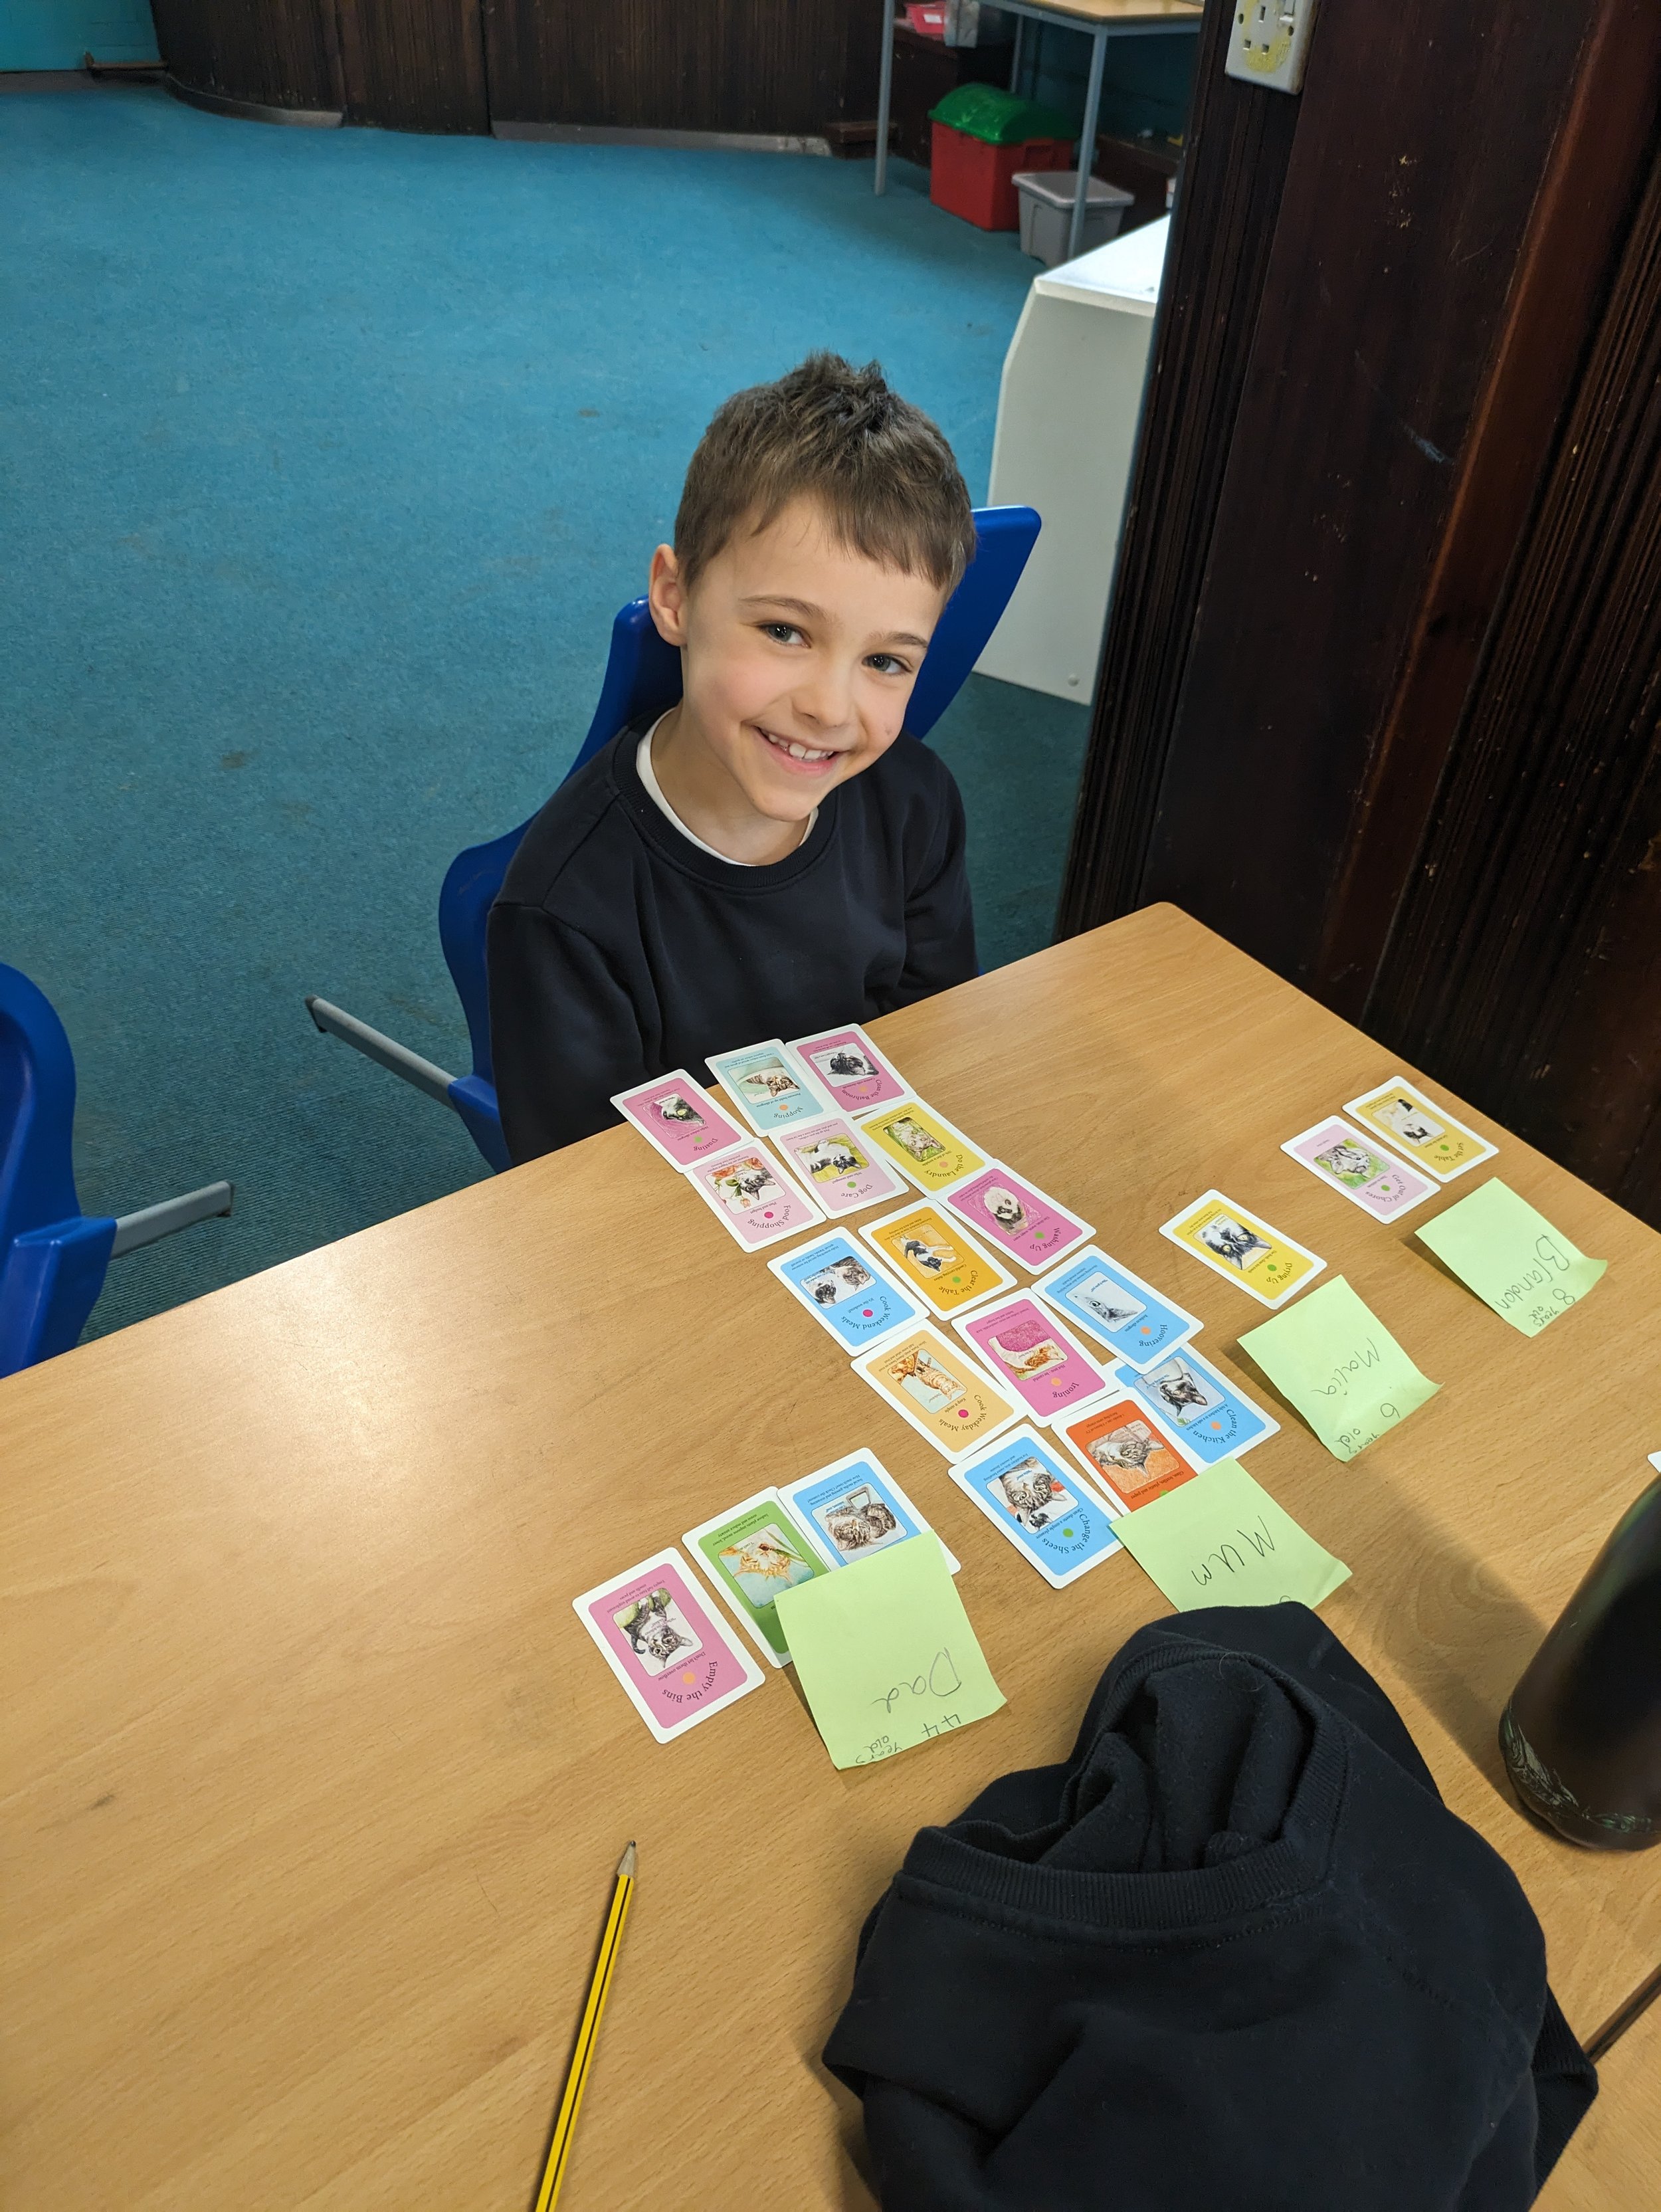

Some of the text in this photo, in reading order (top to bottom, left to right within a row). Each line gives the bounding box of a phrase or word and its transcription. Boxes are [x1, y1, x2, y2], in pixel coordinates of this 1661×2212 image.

[840, 1088, 870, 1100] Bathroom
[773, 1105, 803, 1120] Mopping
[693, 1137, 718, 1151] Dusting
[1452, 1149, 1462, 1157] the
[923, 1153, 963, 1177] Do the Laundry
[1392, 1173, 1403, 1185] Get
[857, 1183, 873, 1195] Dog
[1397, 1183, 1405, 1195] Out
[1365, 1190, 1392, 1202] Chores
[1391, 1193, 1399, 1202] of
[747, 1203, 791, 1229] Food Shopping
[1042, 1226, 1060, 1249] Washing
[969, 1268, 978, 1286] Clear
[1277, 1261, 1292, 1282] Drying
[1494, 1234, 1569, 1310] Brandon
[938, 1286, 959, 1296] Table
[840, 1295, 891, 1330] Cook Weekend Meals
[1528, 1305, 1543, 1319] old
[1533, 1288, 1574, 1328] 8 years
[1139, 1323, 1167, 1347] Hoovering
[1052, 1381, 1080, 1397] Ironing
[957, 1396, 966, 1405] Keep
[937, 1393, 987, 1432] Cook Weekday Meals
[943, 1403, 955, 1413] simple
[1208, 1409, 1219, 1417] kitchen
[1186, 1422, 1198, 1431] kitchen
[1192, 1408, 1236, 1444] Clean the Kitchen
[1347, 1403, 1399, 1454] 6 years
[1334, 1428, 1359, 1448] old
[1159, 1474, 1173, 1484] textiles,
[1172, 1469, 1184, 1478] Glass,
[1147, 1481, 1159, 1490] plastic
[1073, 1507, 1084, 1516] Clean
[746, 1519, 757, 1528] plants
[757, 1514, 769, 1522] Indoor
[732, 1524, 747, 1535] improve
[1048, 1521, 1060, 1531] simple
[717, 1528, 730, 1538] anxiety
[1035, 1528, 1050, 1539] pleasure
[1041, 1513, 1090, 1555] Change the Sheets
[693, 1651, 706, 1661] Don't
[676, 1661, 688, 1672] them
[657, 1668, 677, 1682] overflow
[871, 1647, 961, 1713] Dad
[661, 1661, 720, 1704] Empty the Bins
[921, 1714, 959, 1735] 44
[864, 1735, 888, 1753] old
